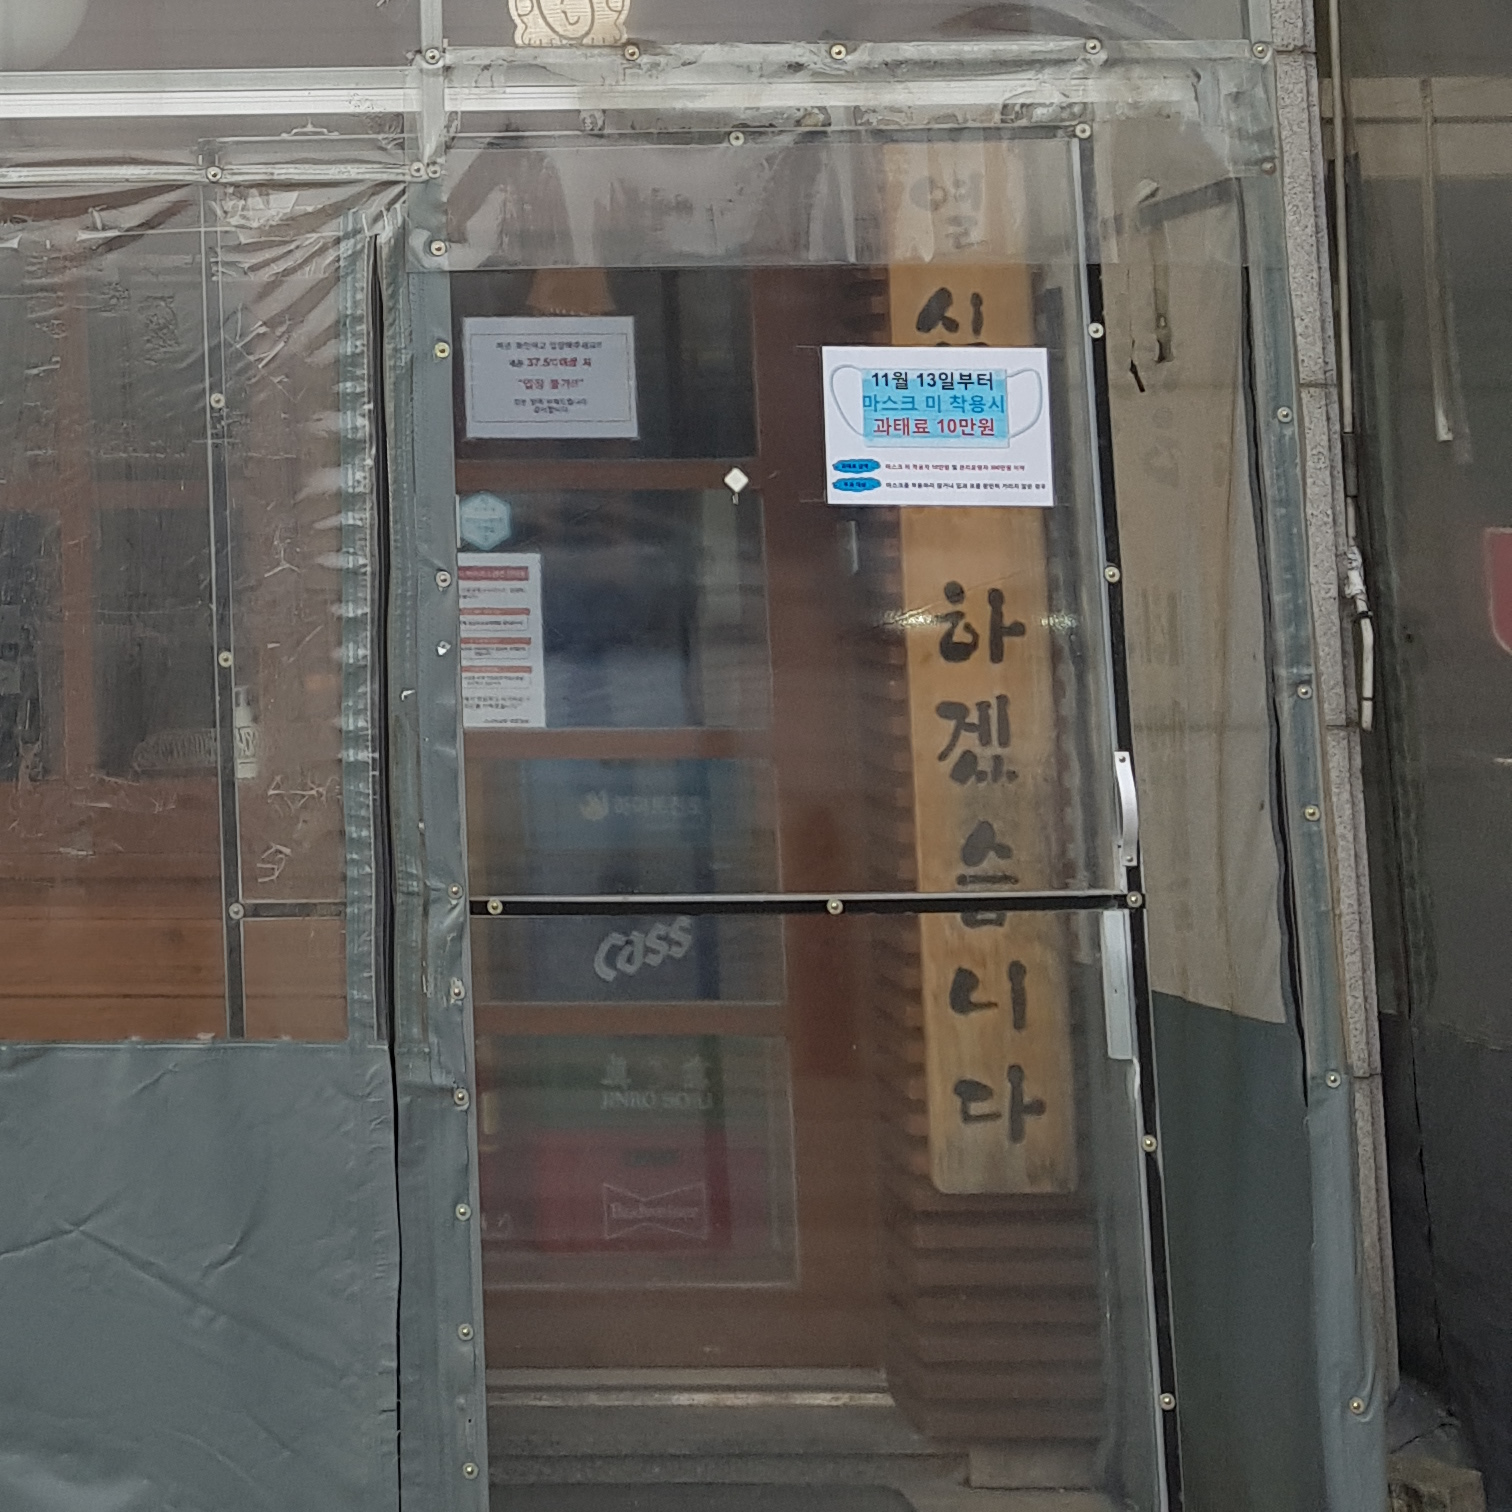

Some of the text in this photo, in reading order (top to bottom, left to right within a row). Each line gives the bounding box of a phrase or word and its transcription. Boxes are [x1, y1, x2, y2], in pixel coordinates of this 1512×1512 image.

[870, 371, 994, 391] 11월 13일부터
[863, 393, 1005, 414] 마스크 미 착용시
[873, 417, 996, 437] 과태료 10만원
[592, 916, 693, 982] Cass
